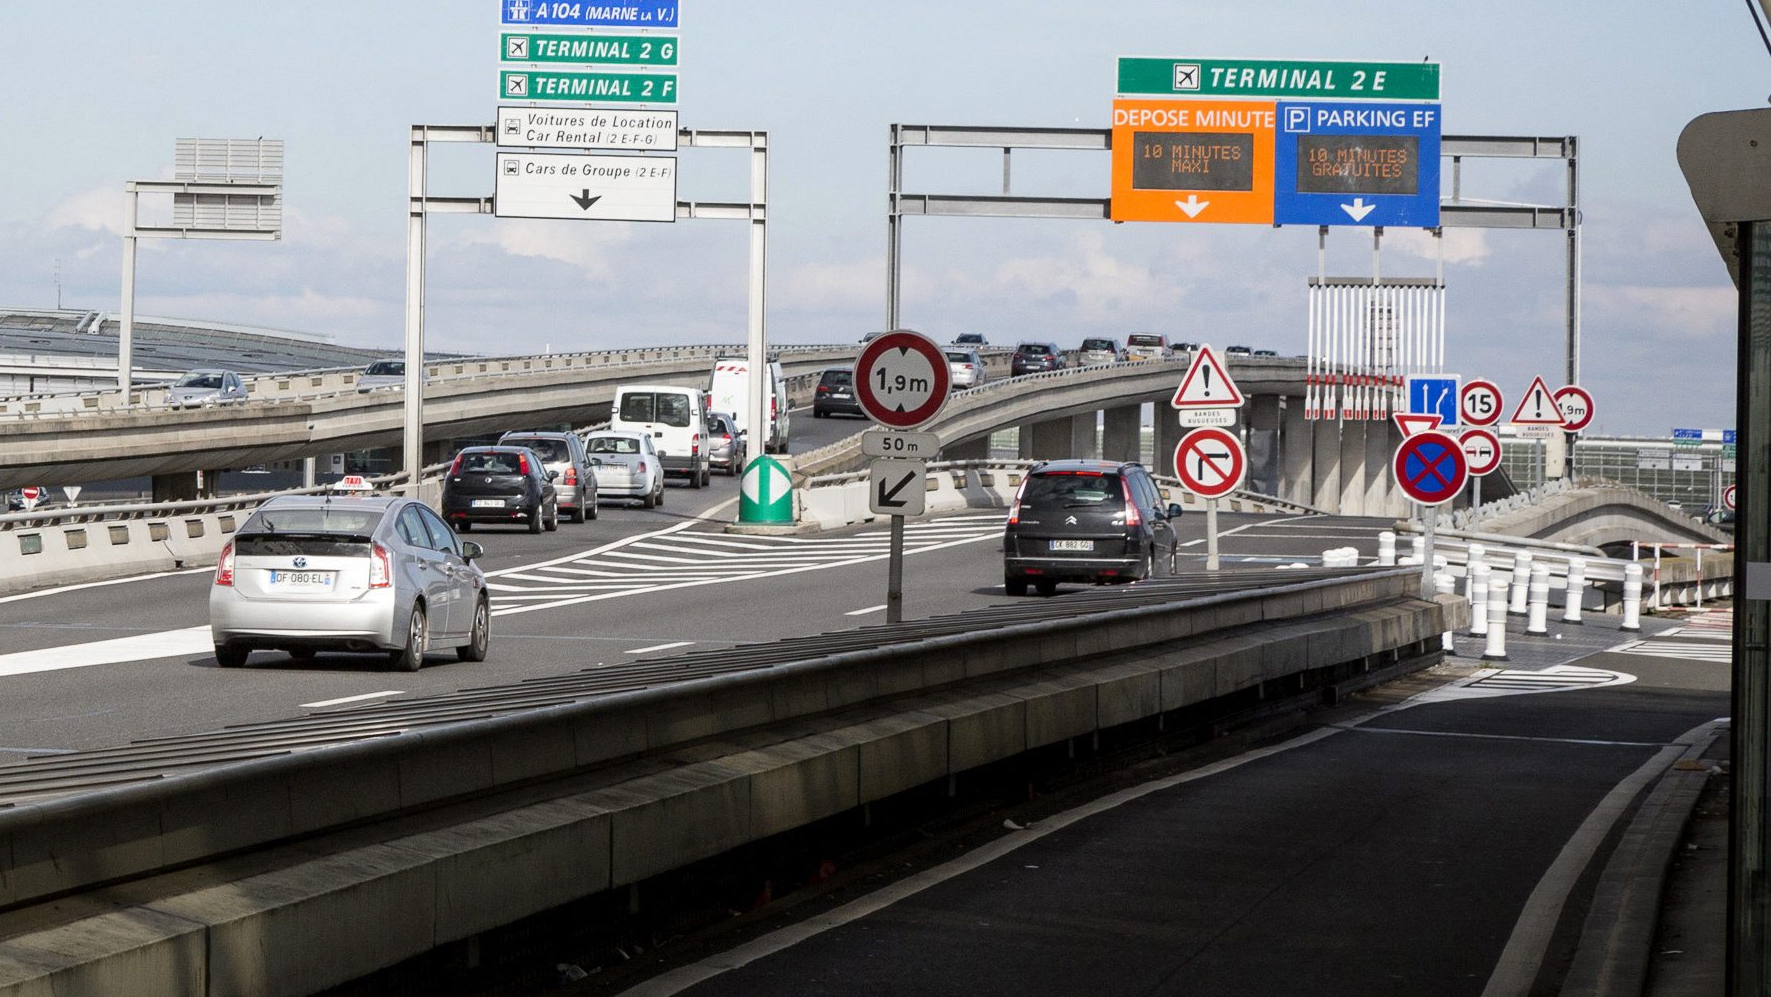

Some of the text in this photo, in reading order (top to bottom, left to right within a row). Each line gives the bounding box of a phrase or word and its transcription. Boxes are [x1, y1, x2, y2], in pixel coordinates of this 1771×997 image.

[640, 12, 652, 20] LA
[536, 40, 674, 59] TERMINAL 2 G
[535, 78, 674, 96] TERMINAL 2 F
[1211, 68, 1386, 90] TERMINAL 2 E
[528, 114, 672, 128] Voitures de Location
[1114, 109, 1274, 128] DEPOSE MINUTE
[1318, 110, 1406, 127] PARKING
[1413, 111, 1434, 128] EF
[526, 130, 550, 142] Car
[556, 130, 601, 143] Rental
[1144, 144, 1242, 160] 10 MINUTES
[1309, 148, 1408, 164] 10 MINUTES
[526, 162, 556, 175] Cars
[562, 164, 577, 176] de
[582, 164, 630, 179] Groupe
[1172, 160, 1210, 173] MAXI
[1312, 163, 1402, 178] GRATUITES
[1468, 394, 1492, 414] 15
